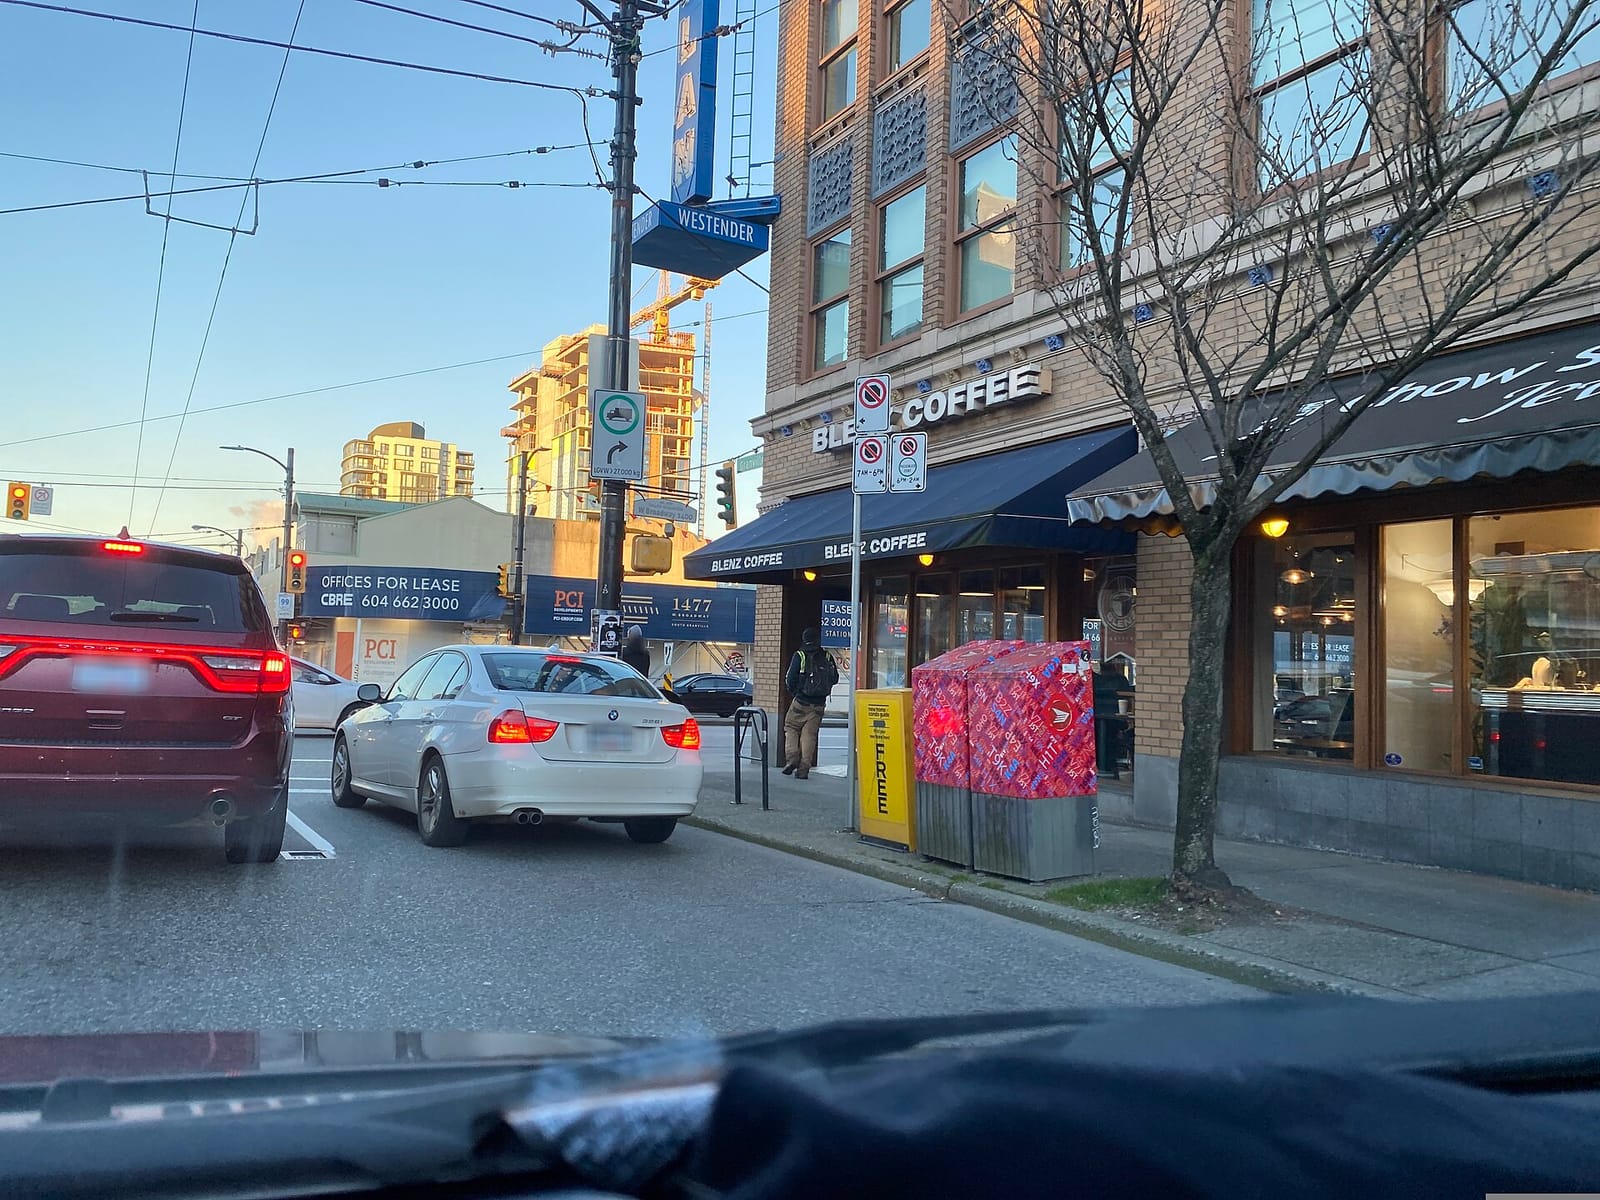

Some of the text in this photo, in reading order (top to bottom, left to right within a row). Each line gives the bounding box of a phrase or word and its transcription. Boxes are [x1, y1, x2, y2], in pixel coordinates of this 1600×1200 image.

[678, 207, 754, 243] WESTENDER
[902, 364, 1042, 428] COFFEE
[869, 532, 927, 554] COFFEE
[711, 552, 783, 572] BLENZ COFFEE
[321, 575, 460, 592] OFFICES FOR LEASE
[320, 593, 459, 610] CBRE 604 662 3000
[553, 590, 584, 608] PCI
[671, 597, 712, 612] 1477
[824, 604, 852, 615] LEASE
[831, 617, 852, 627] 3000
[1082, 621, 1099, 630] FOR
[364, 639, 397, 659] PCI
[988, 745, 1008, 776] T9K
[1039, 742, 1058, 770] H1T
[876, 743, 888, 814] FREE
